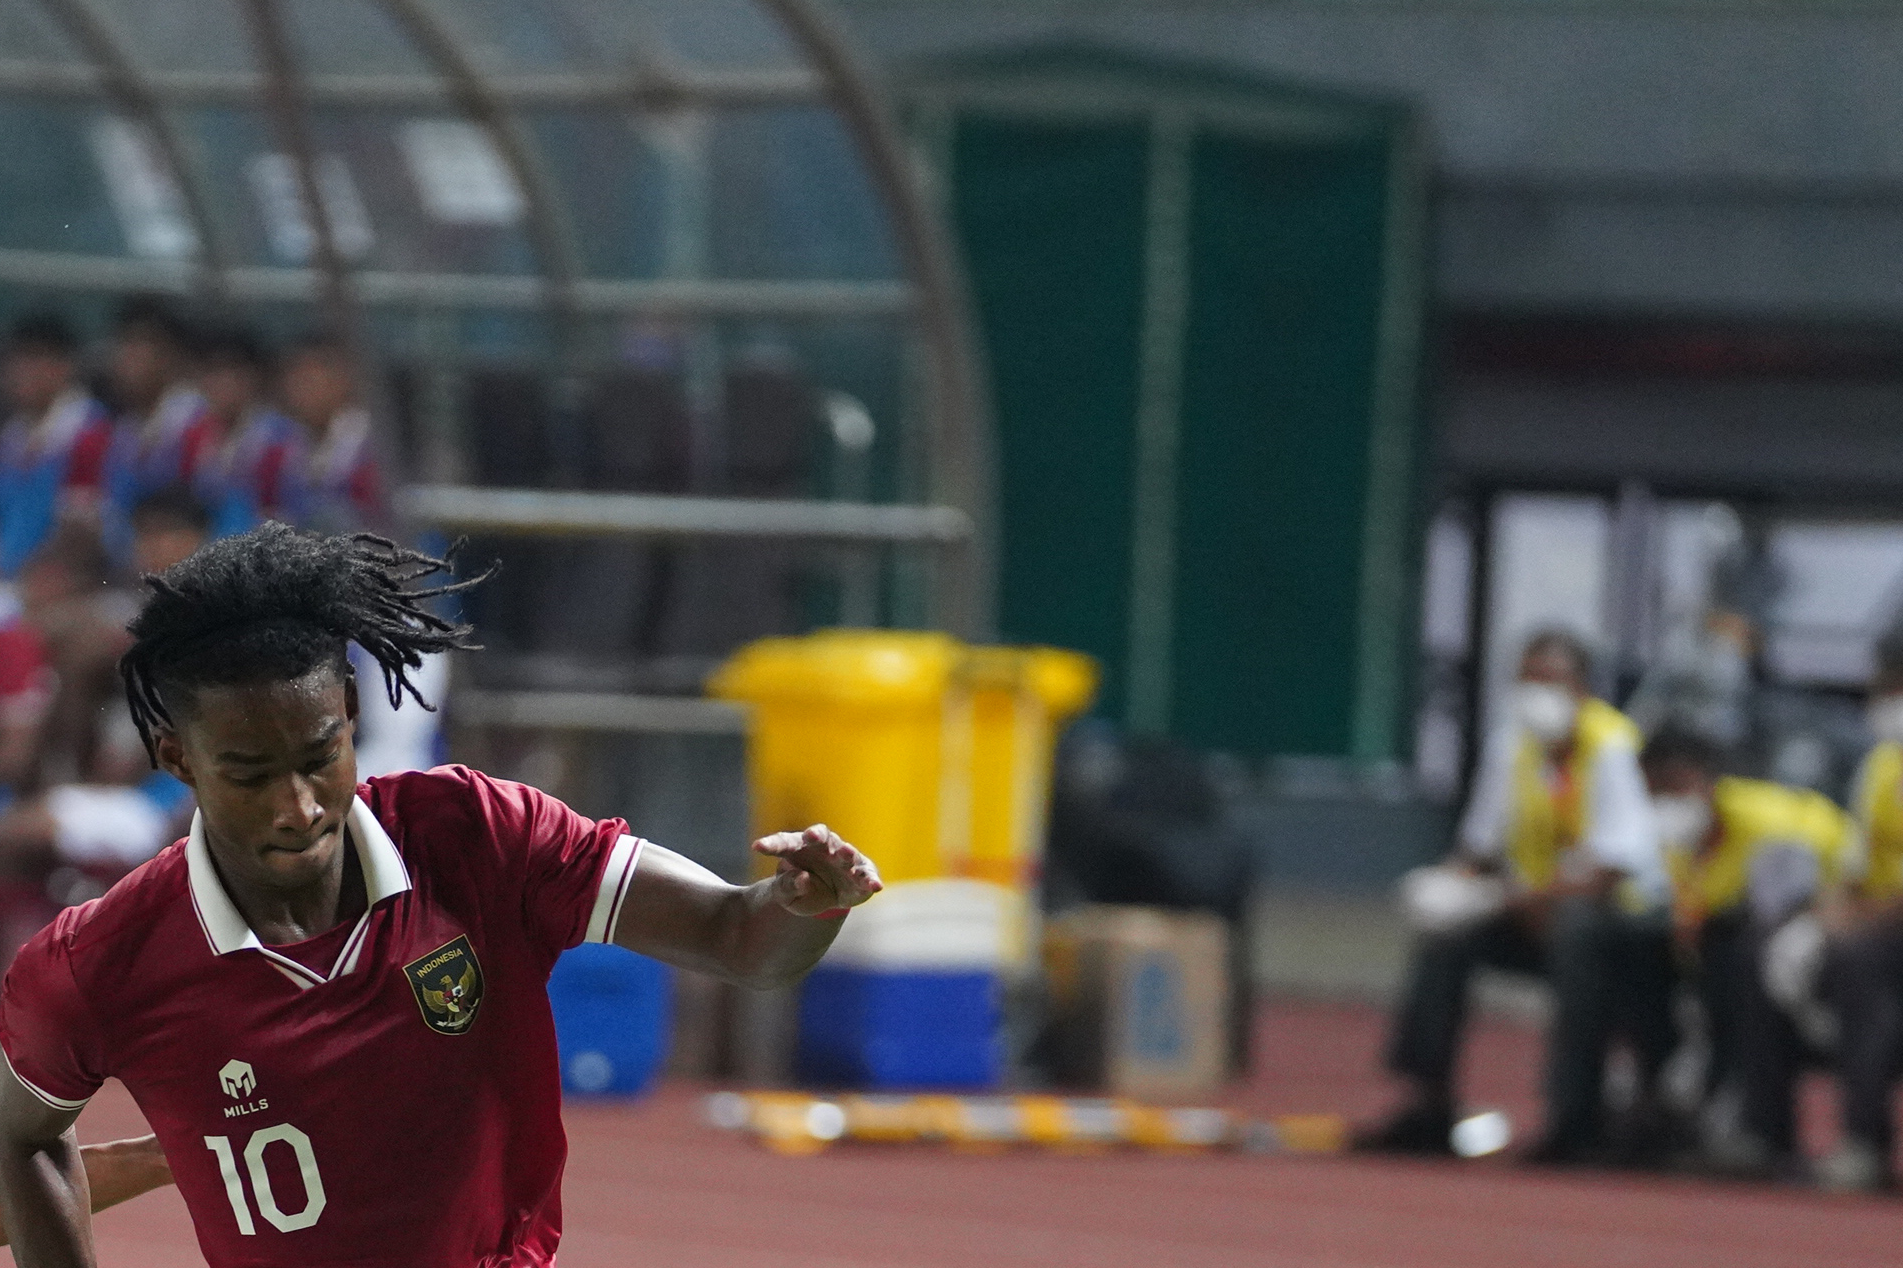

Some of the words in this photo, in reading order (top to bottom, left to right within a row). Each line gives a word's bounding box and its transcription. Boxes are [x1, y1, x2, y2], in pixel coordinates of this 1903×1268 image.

[416, 947, 464, 978] INDONESIA
[223, 1098, 269, 1118] MILLS
[203, 1122, 327, 1236] 10
